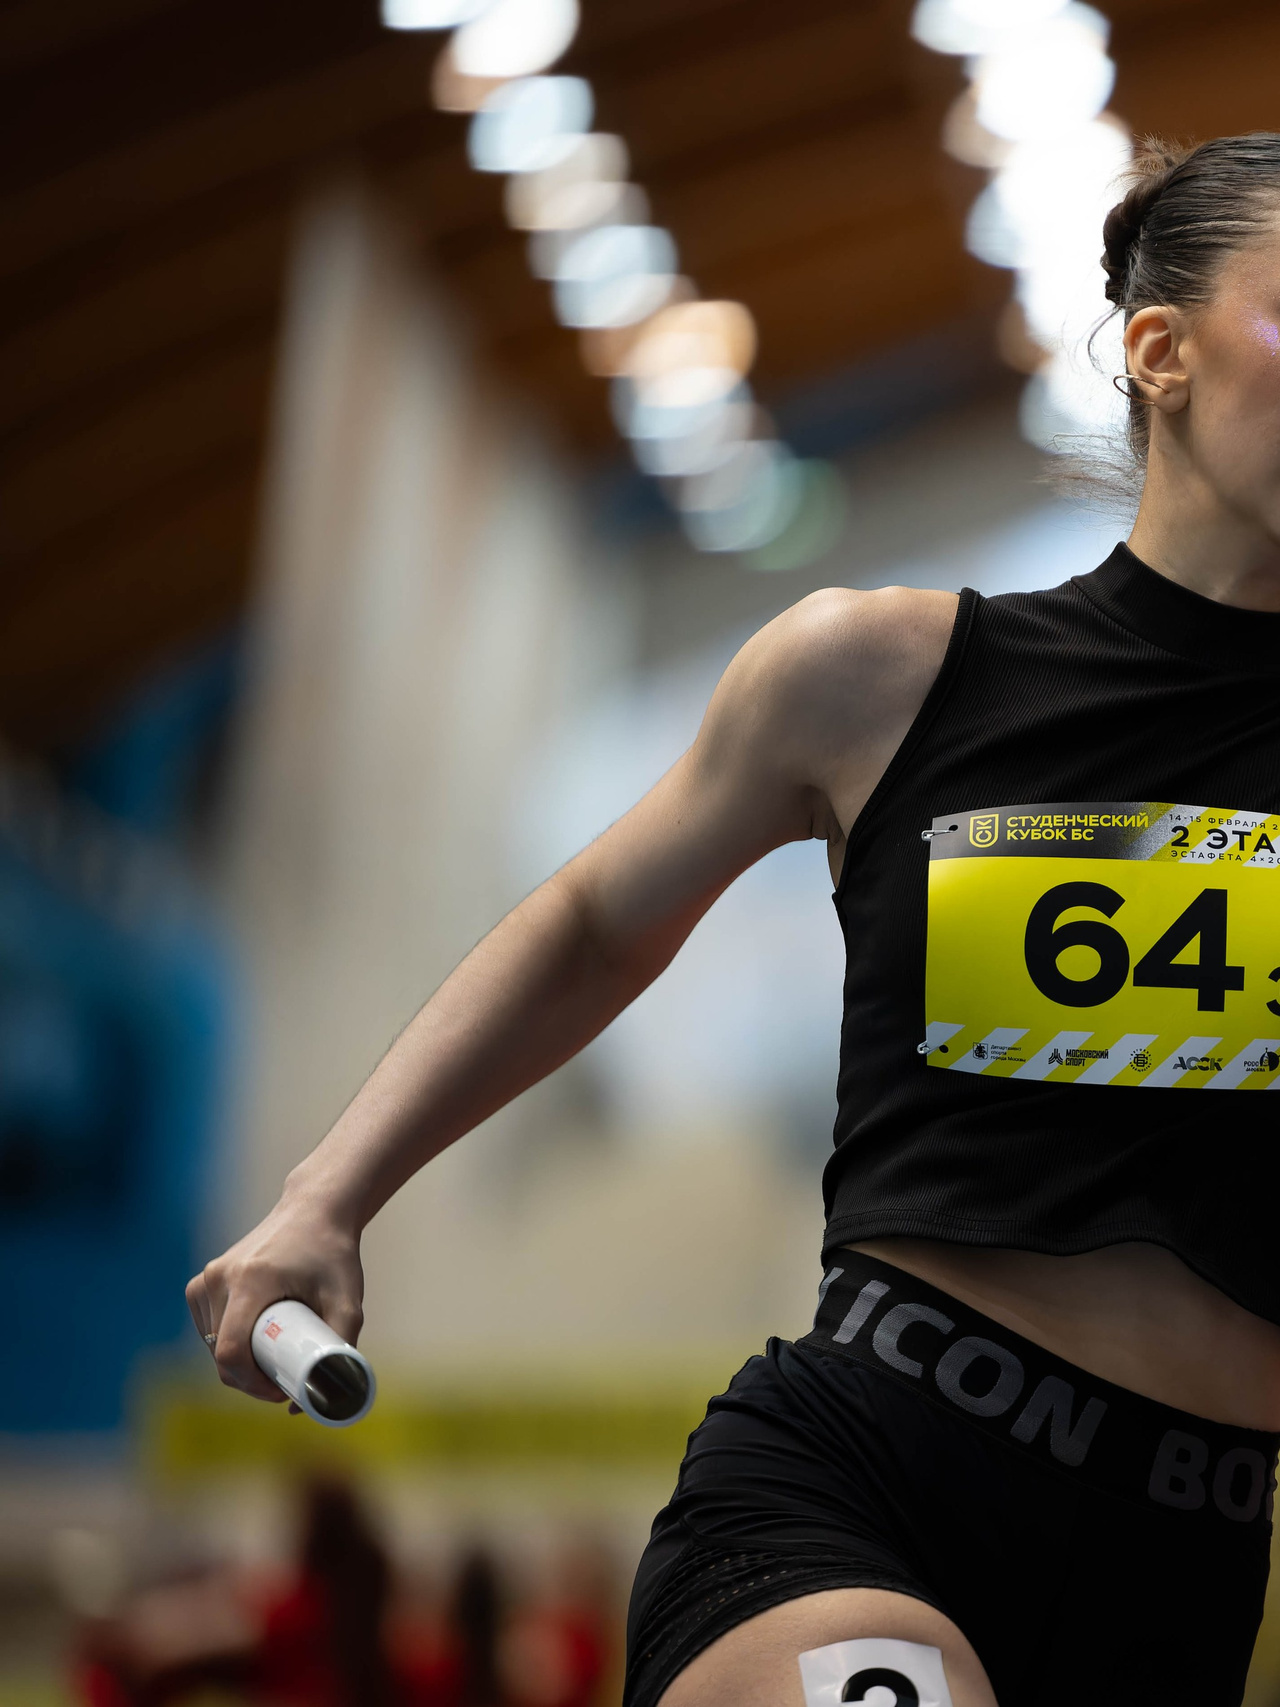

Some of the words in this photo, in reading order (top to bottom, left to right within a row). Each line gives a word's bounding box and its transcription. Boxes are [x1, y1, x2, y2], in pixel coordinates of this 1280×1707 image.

[1006, 812, 1149, 828] СТУДЕНЧЕСКИЙ
[1208, 817, 1266, 829] ФЕВРАЛЯ
[1006, 829, 1067, 840] КУБОК
[1071, 829, 1094, 841] БС
[1171, 825, 1190, 847] 2
[1170, 850, 1243, 861] ЭСТАФЕТА
[1024, 881, 1245, 1012] 64
[1066, 1049, 1109, 1059] МОСКОВСКИЙ
[1065, 1058, 1086, 1067] СПОРТ
[832, 1279, 1107, 1467] ICON
[1147, 1429, 1278, 1523] BO
